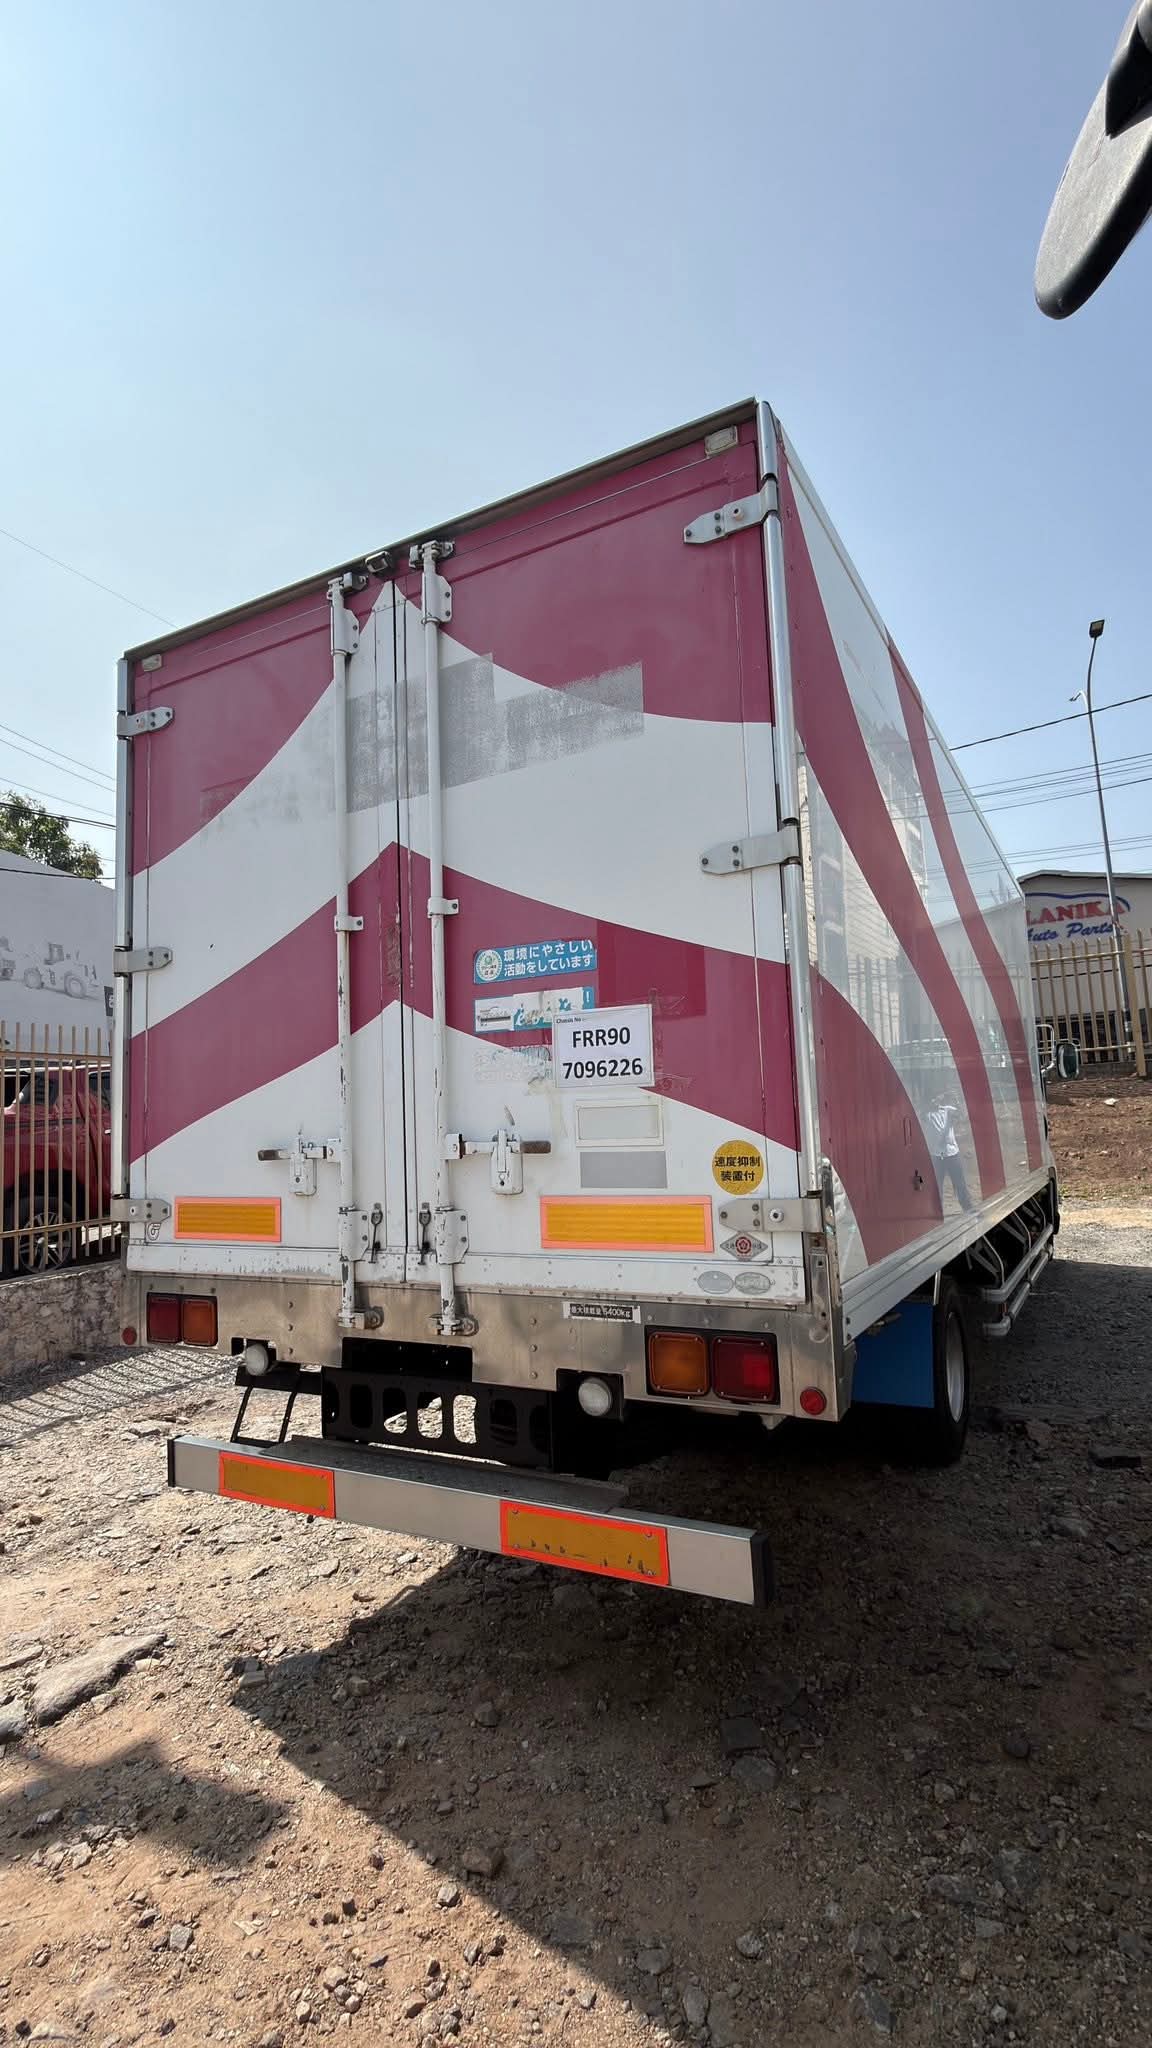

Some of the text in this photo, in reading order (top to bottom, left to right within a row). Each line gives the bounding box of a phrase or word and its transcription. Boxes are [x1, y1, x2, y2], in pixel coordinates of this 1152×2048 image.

[504, 940, 593, 962] 環境にやさしい
[504, 954, 593, 977] 活動をしています
[572, 1027, 631, 1048] FRR90
[563, 1058, 643, 1079] 7096226
[714, 1156, 761, 1168] 速度抑制
[720, 1170, 756, 1182] 装置付
